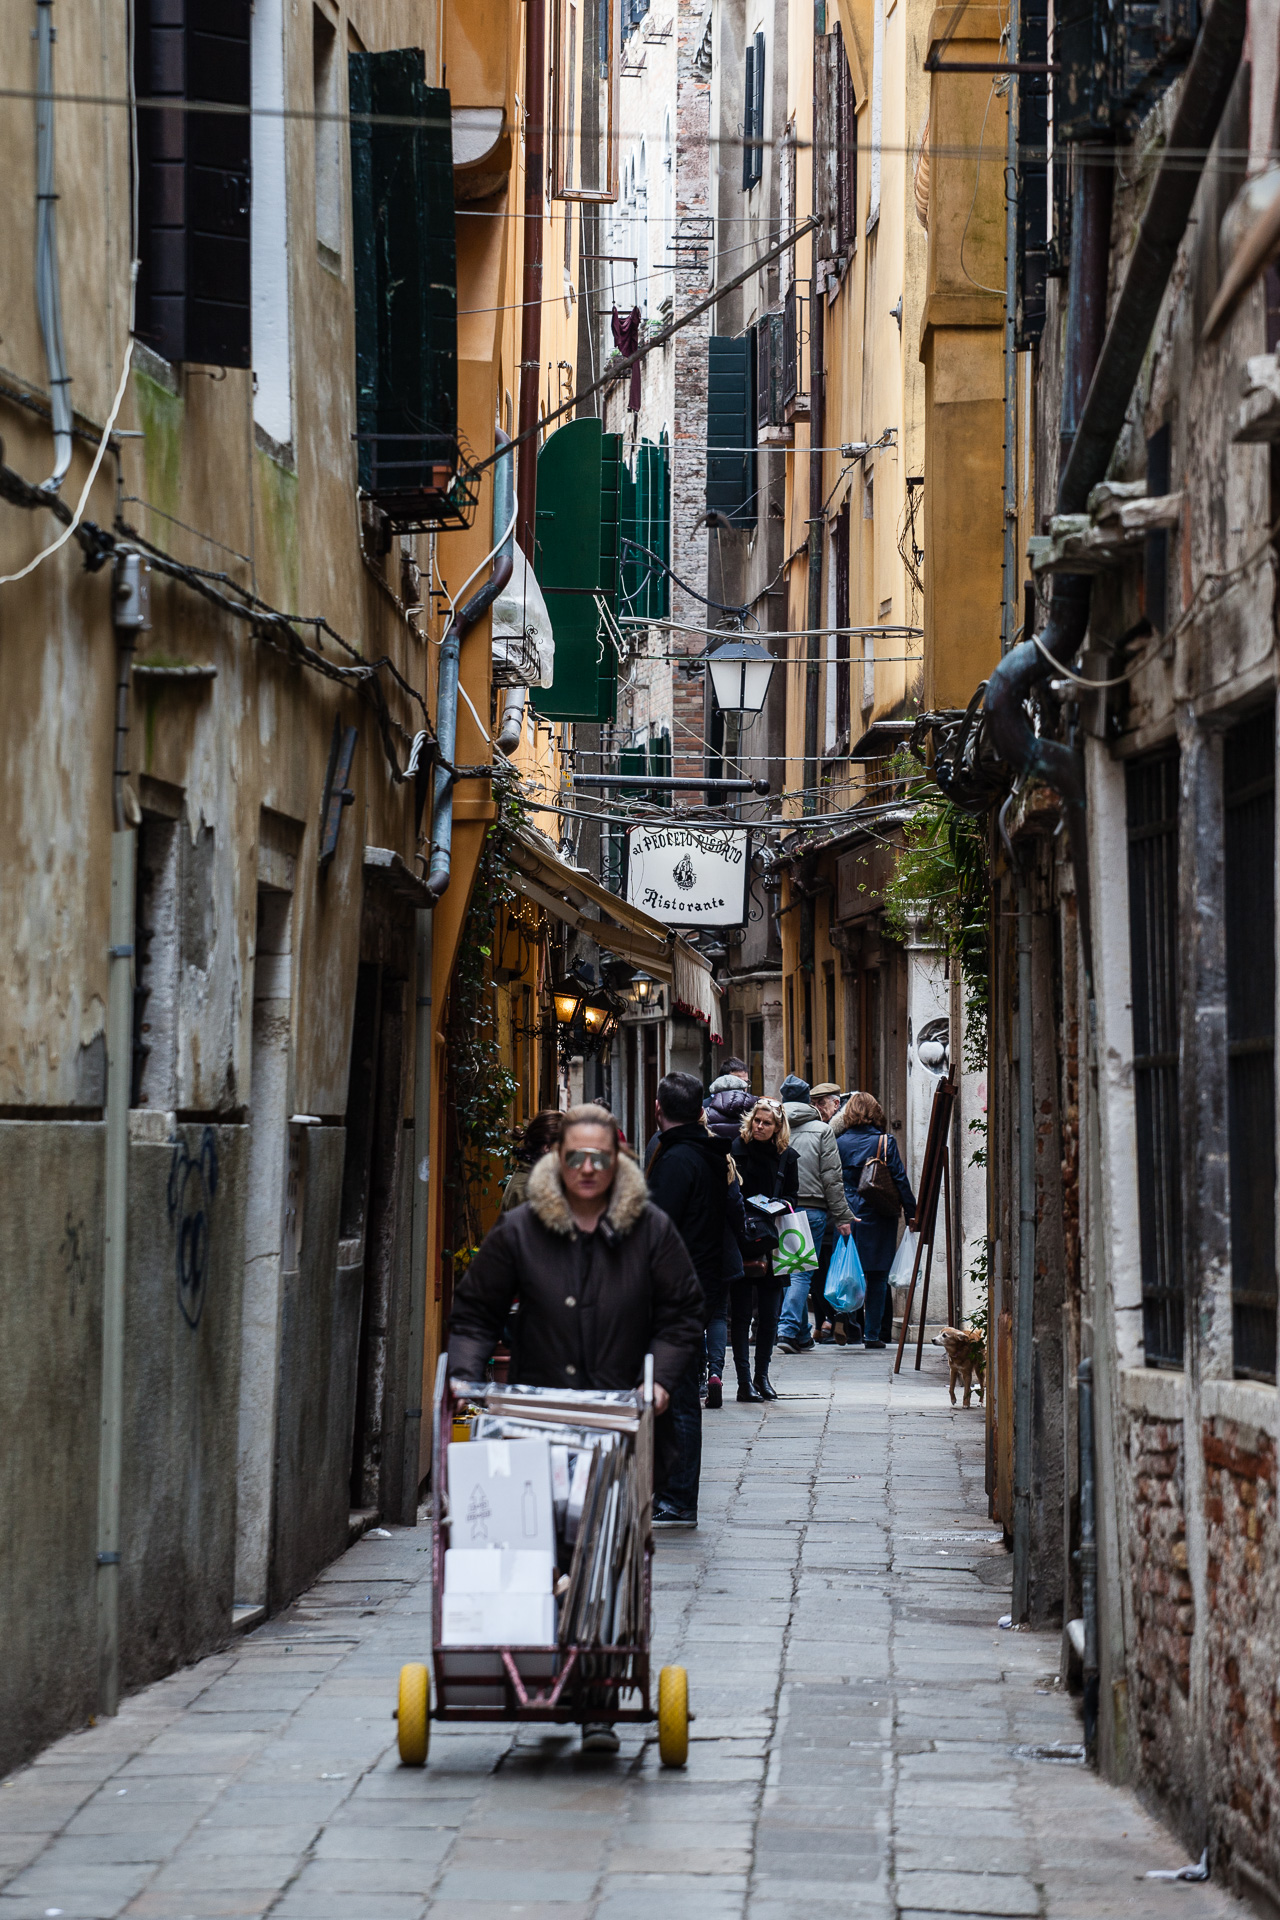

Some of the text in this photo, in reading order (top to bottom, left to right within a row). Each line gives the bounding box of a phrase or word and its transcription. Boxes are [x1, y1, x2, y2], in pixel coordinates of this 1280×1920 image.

[643, 831, 693, 852] PEOCETO
[695, 834, 743, 864] RISORTO
[642, 887, 725, 912] Ristorante
